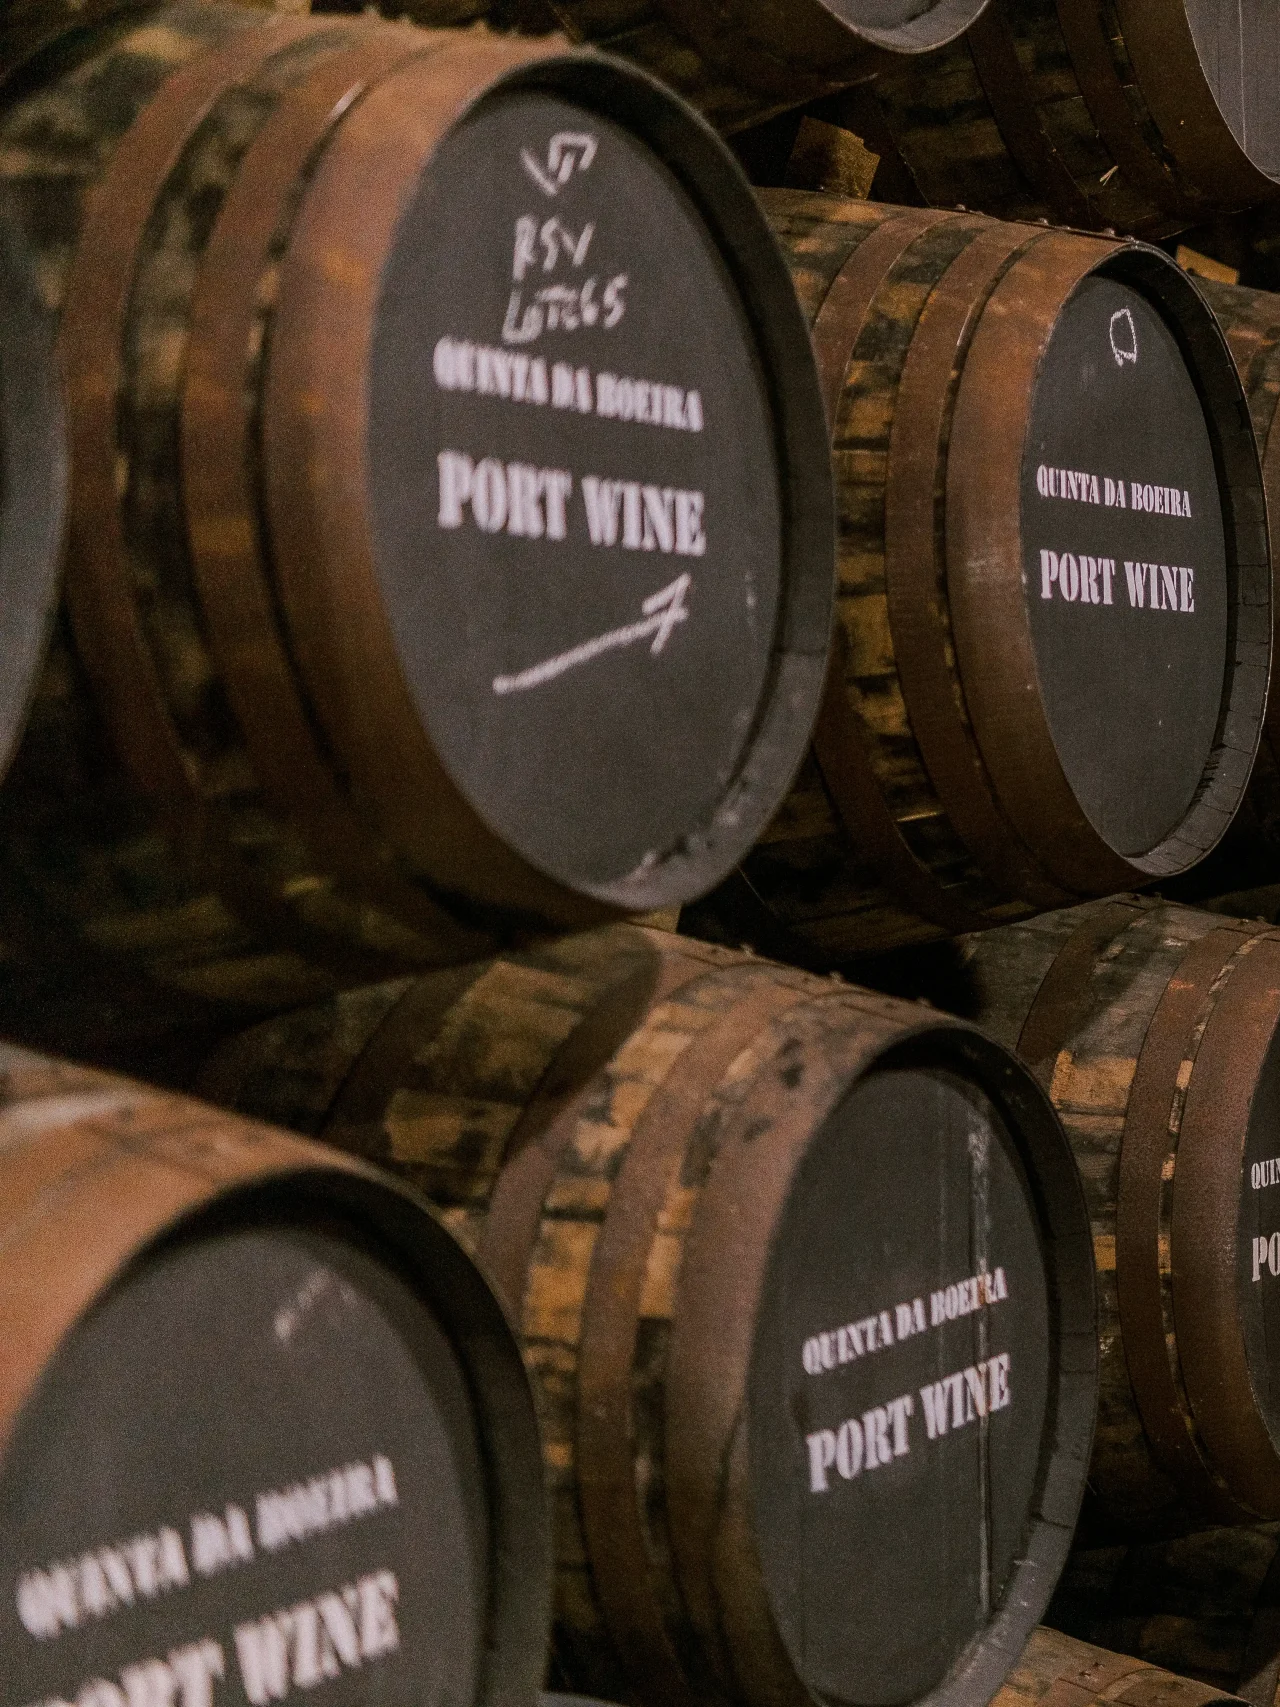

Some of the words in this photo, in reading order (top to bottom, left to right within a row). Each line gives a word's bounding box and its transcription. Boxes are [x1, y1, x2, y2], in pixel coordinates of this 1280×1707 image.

[552, 361, 592, 414] DA
[437, 449, 573, 542] PORT
[581, 474, 707, 557] WINE
[1036, 464, 1100, 505] QUINTA
[1104, 477, 1126, 508] DA
[1131, 482, 1192, 518] BOEIRA
[1039, 549, 1116, 605] PORT
[1124, 561, 1195, 613] WINE
[802, 1309, 895, 1376] QUINTA
[895, 1297, 928, 1341] DA
[805, 1393, 916, 1493] PORT
[918, 1351, 1012, 1441] WINE
[232, 1567, 400, 1706] WINE
